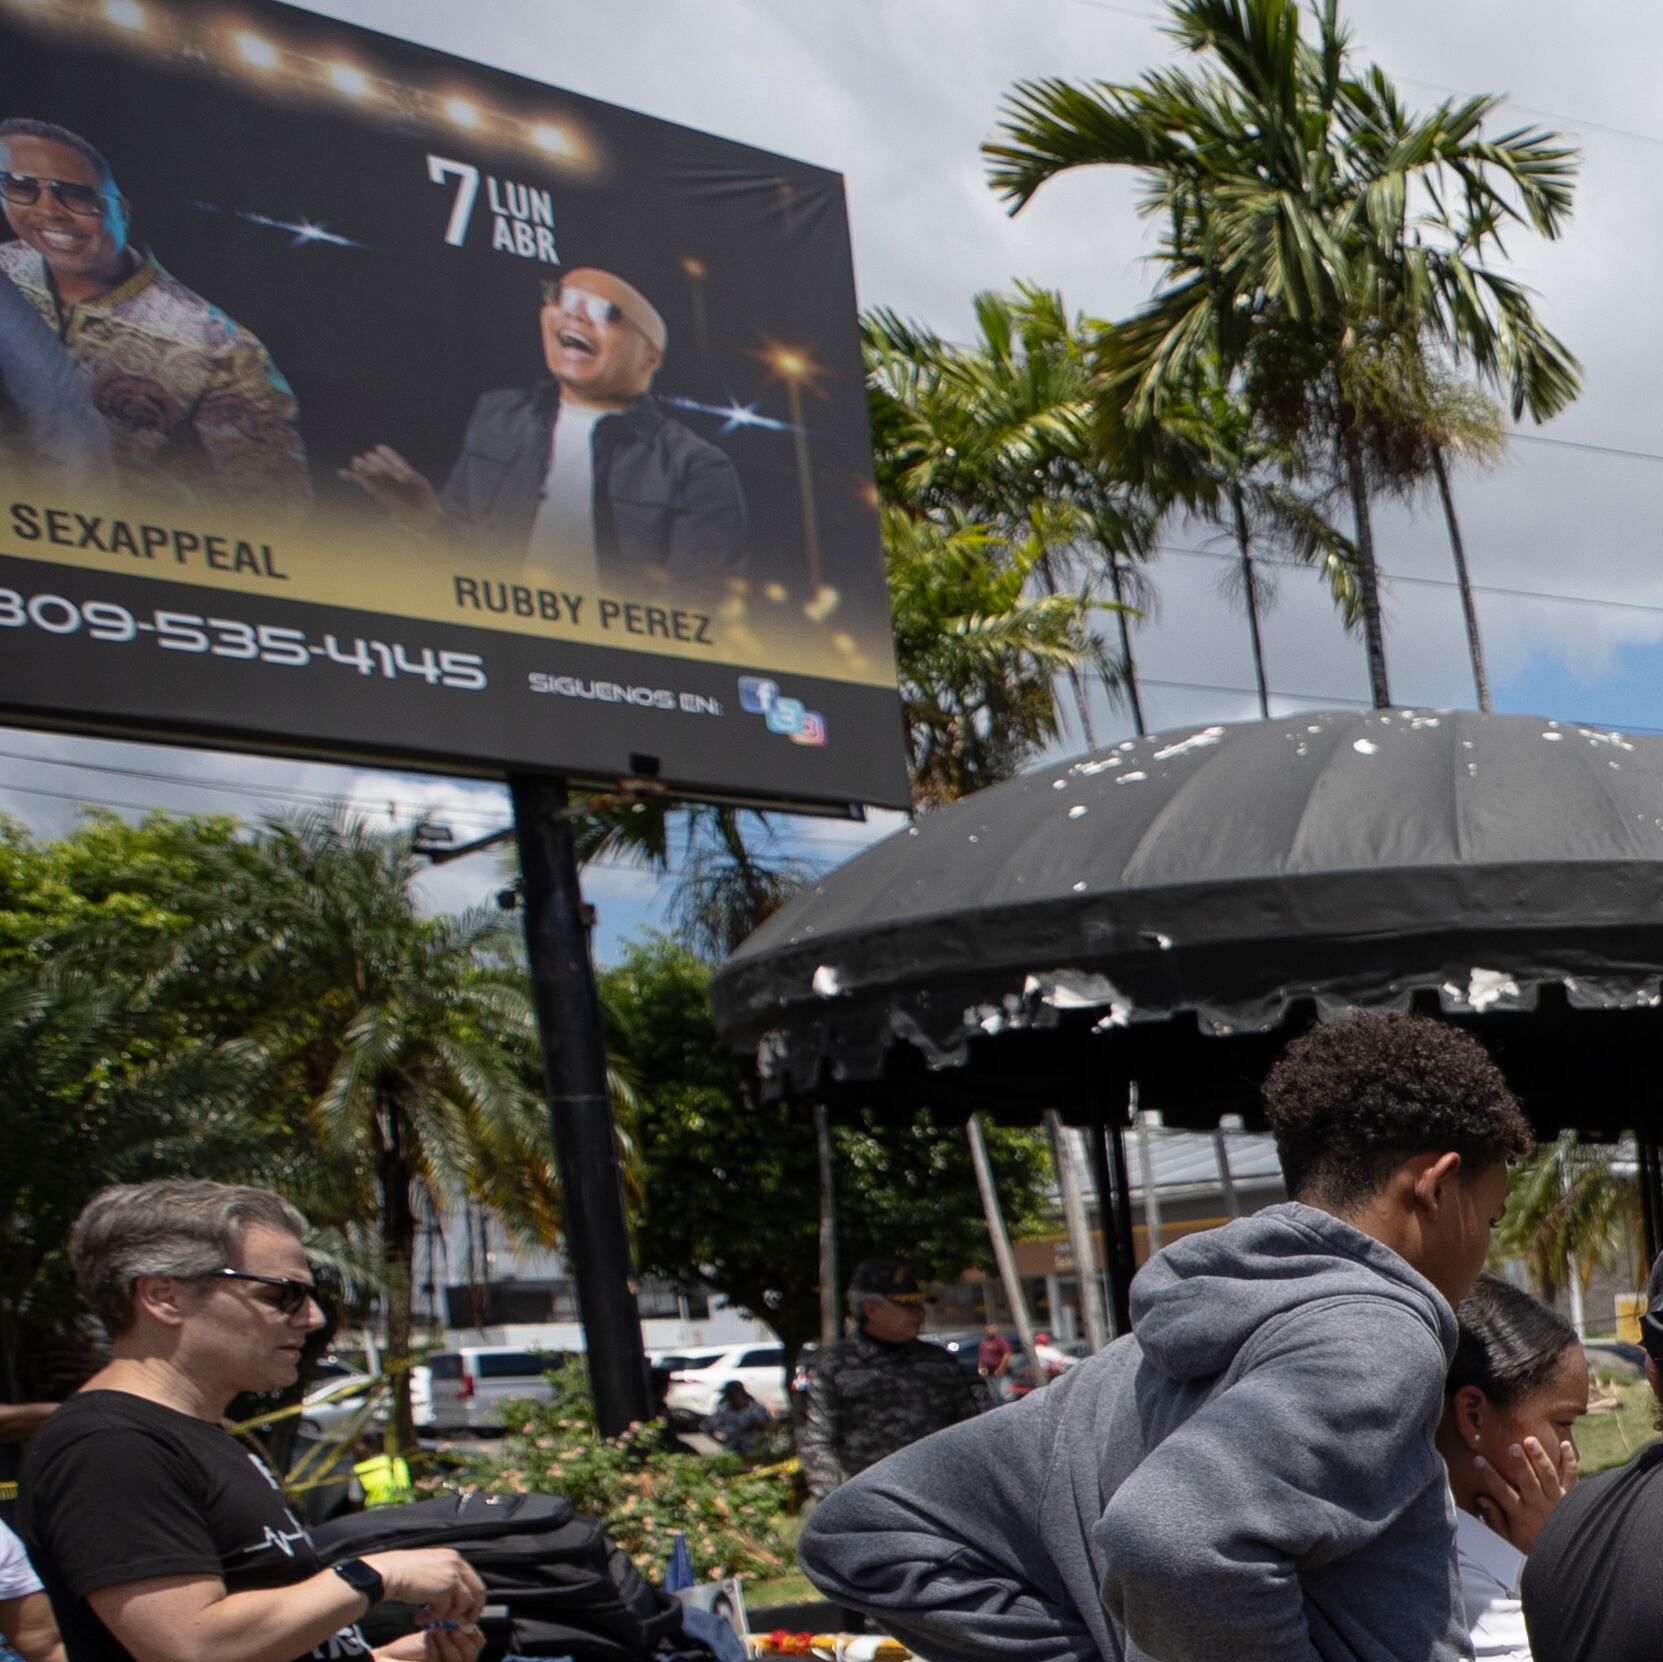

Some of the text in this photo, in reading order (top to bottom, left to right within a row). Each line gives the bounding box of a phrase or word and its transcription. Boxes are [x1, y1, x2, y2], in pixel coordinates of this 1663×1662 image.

[426, 153, 555, 247] 7 LUN
[492, 214, 561, 267] ABR
[9, 502, 289, 581] SEXAPPEAL
[453, 575, 714, 645] RUBBY PEREZ
